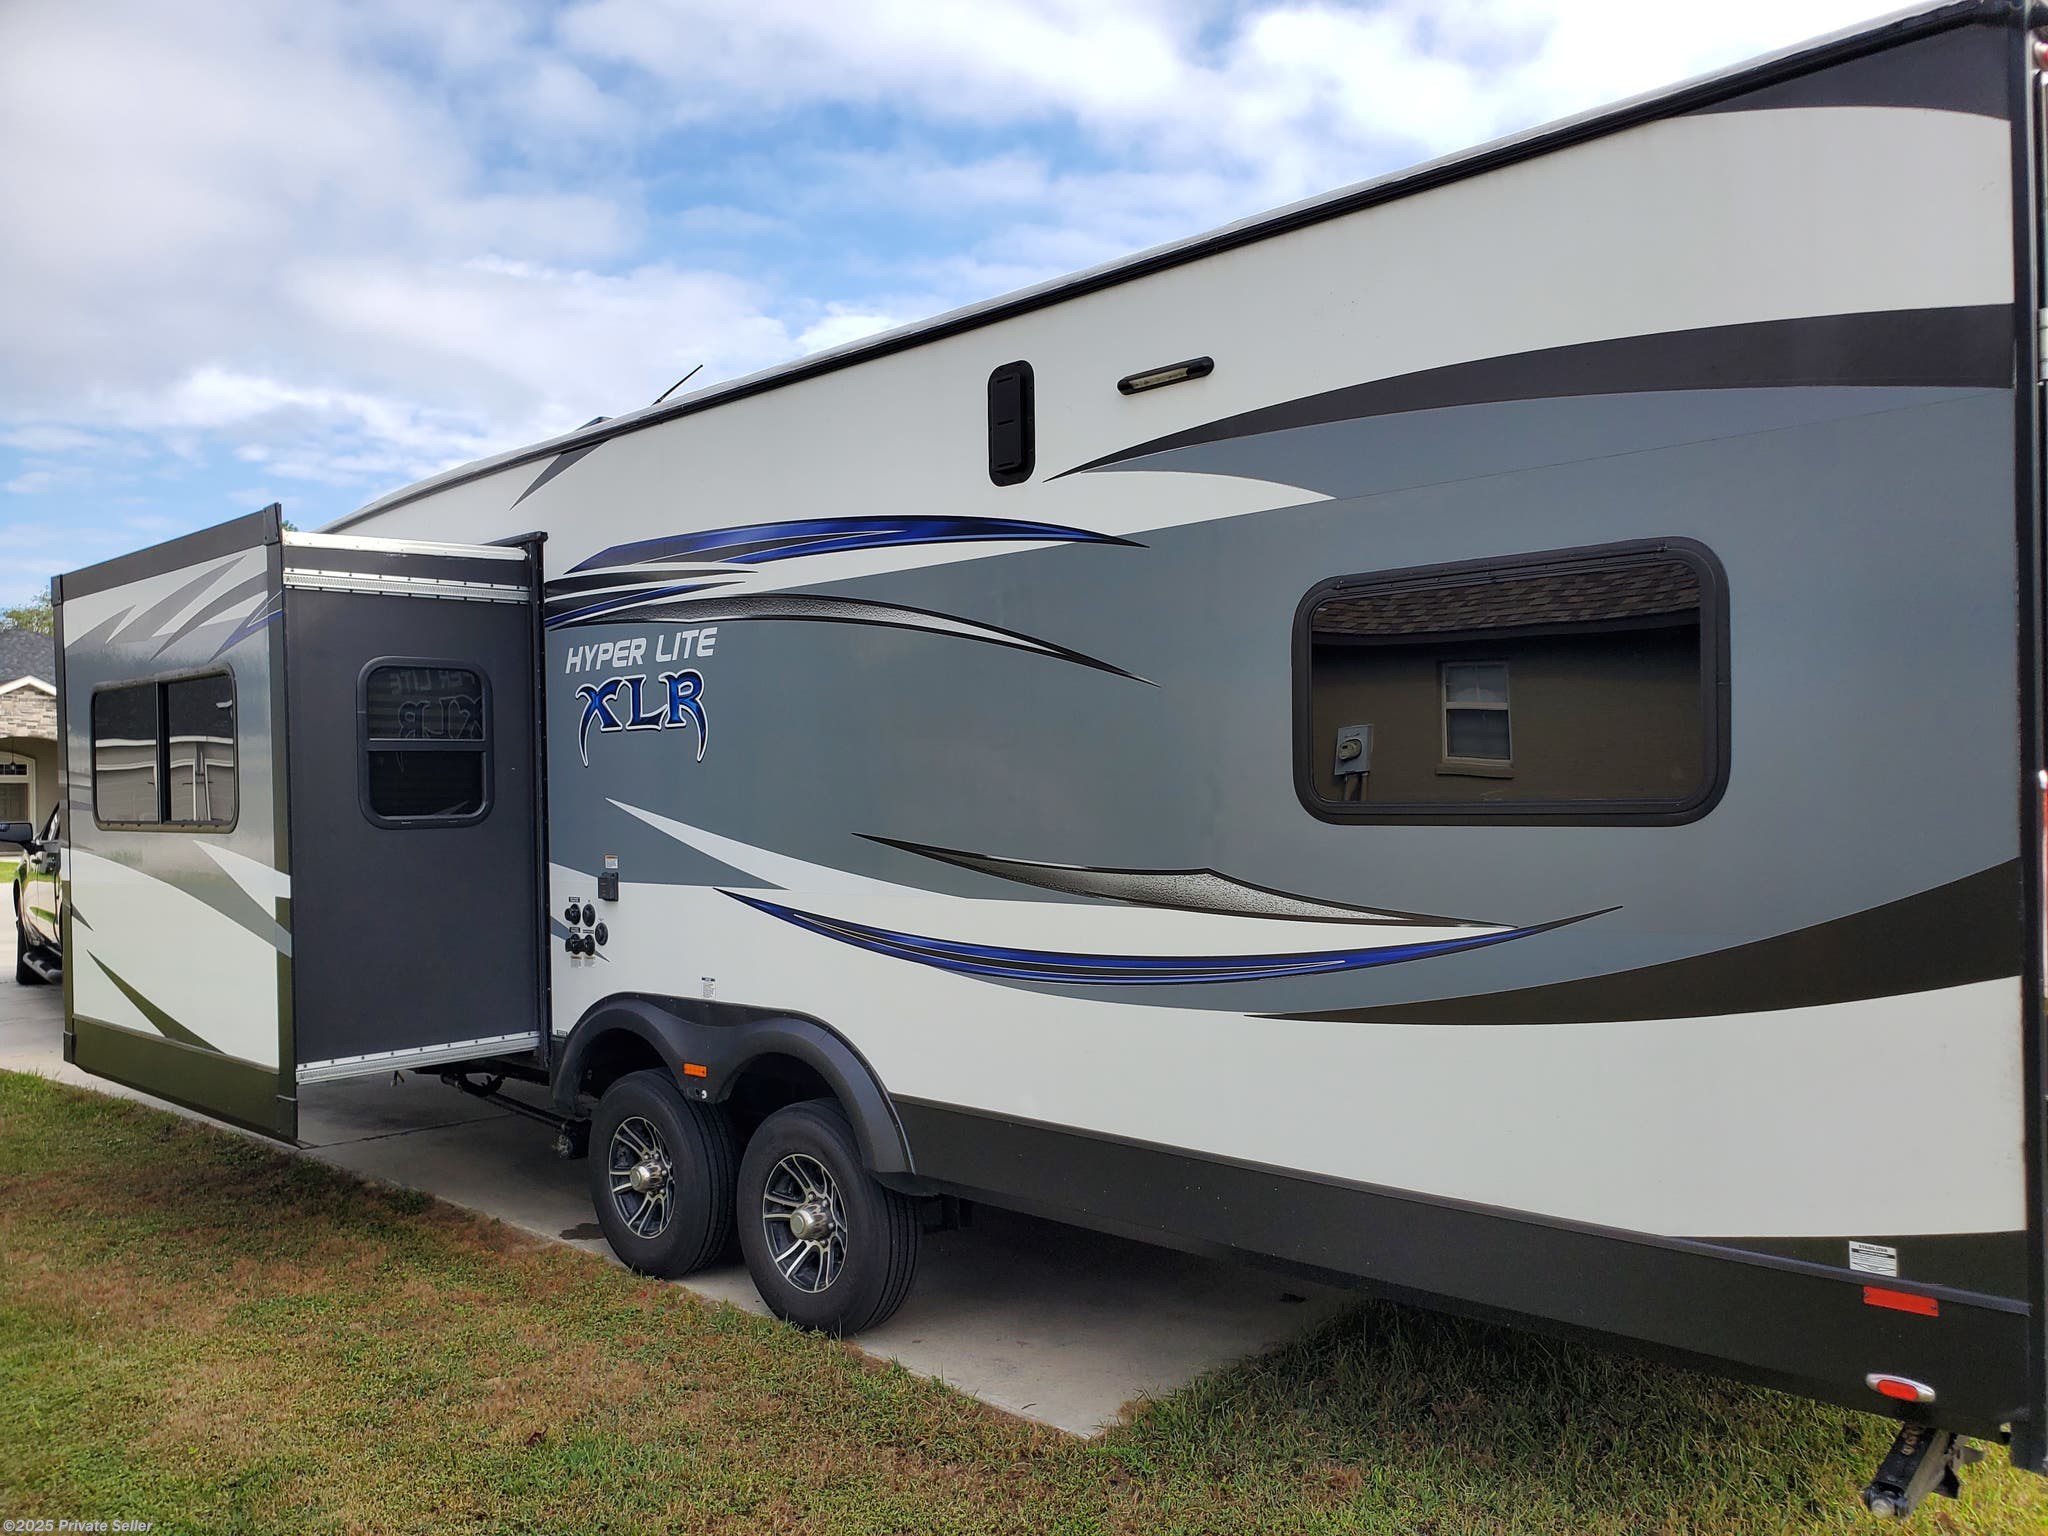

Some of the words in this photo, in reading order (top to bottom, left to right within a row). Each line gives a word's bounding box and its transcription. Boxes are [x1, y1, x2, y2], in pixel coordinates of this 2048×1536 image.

[565, 637, 647, 674] HYPER
[655, 627, 718, 663] LITE
[575, 668, 709, 767] XLR
